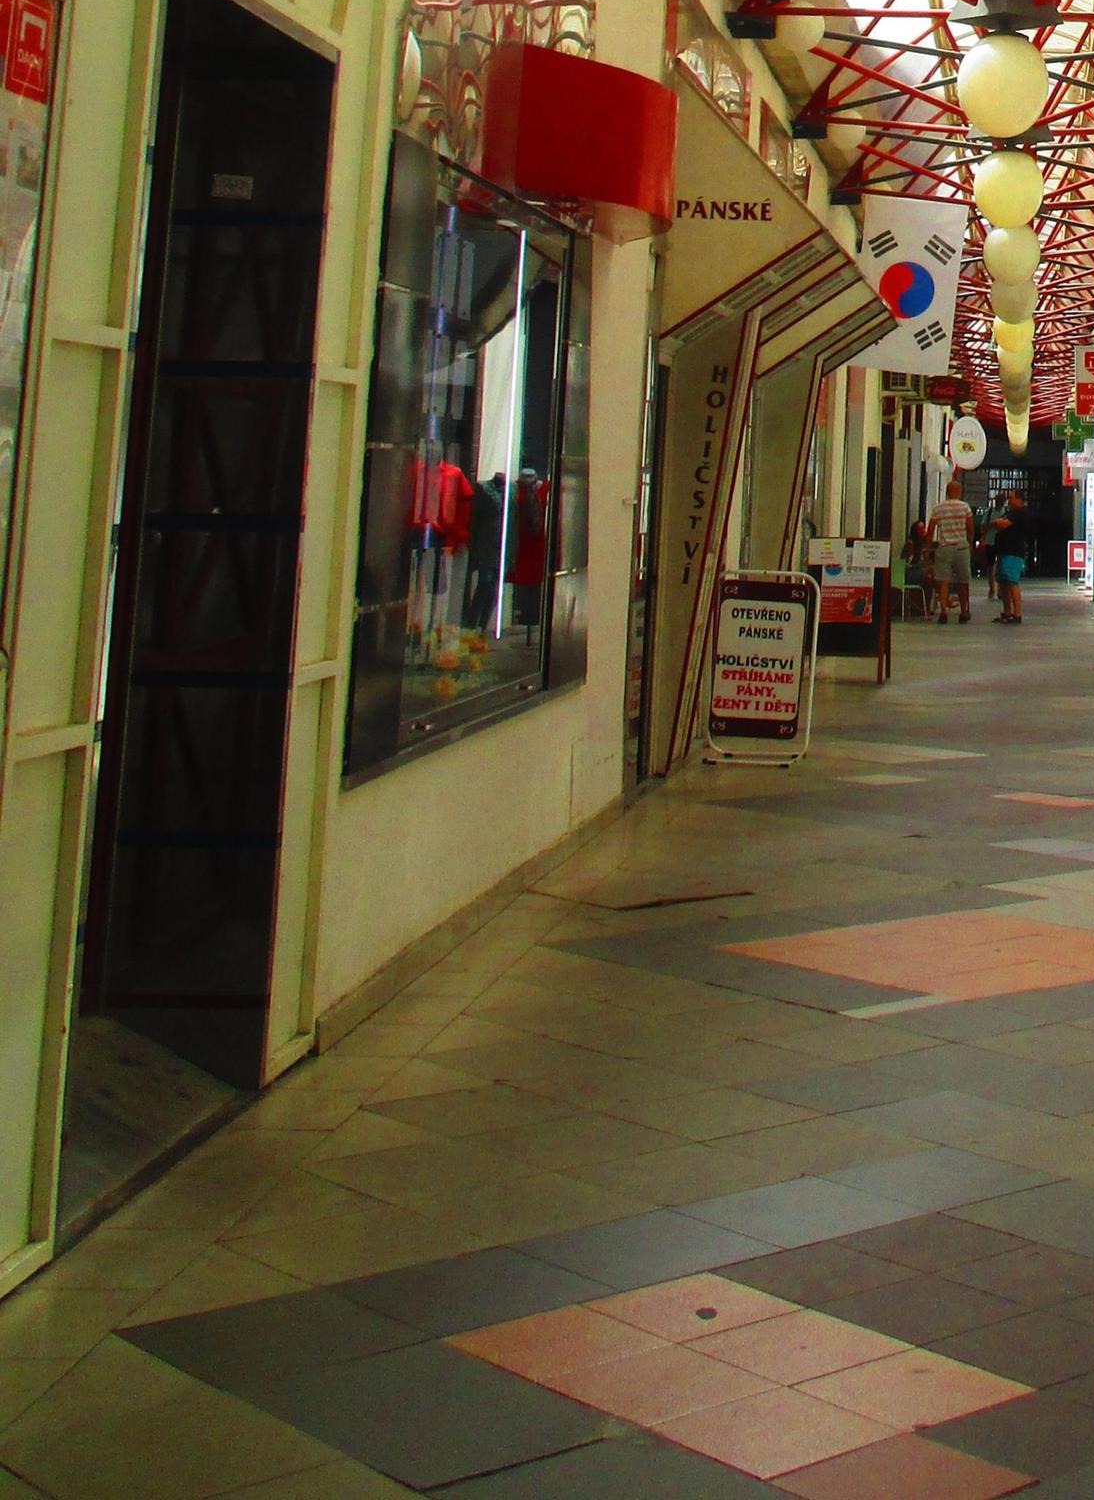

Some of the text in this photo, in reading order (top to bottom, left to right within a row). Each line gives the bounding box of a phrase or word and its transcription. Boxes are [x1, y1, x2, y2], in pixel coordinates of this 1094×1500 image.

[676, 195, 773, 222] PÁNSKÉ
[682, 365, 728, 584] HOLIČSTVÍ
[732, 606, 791, 622] OTEVŘENO
[738, 624, 784, 640] PÁNSKÉ
[717, 654, 794, 670] HOLIČSTVÍ
[721, 669, 794, 684] STŘÍHÁME
[713, 696, 796, 713] ŽENY I DĚTI
